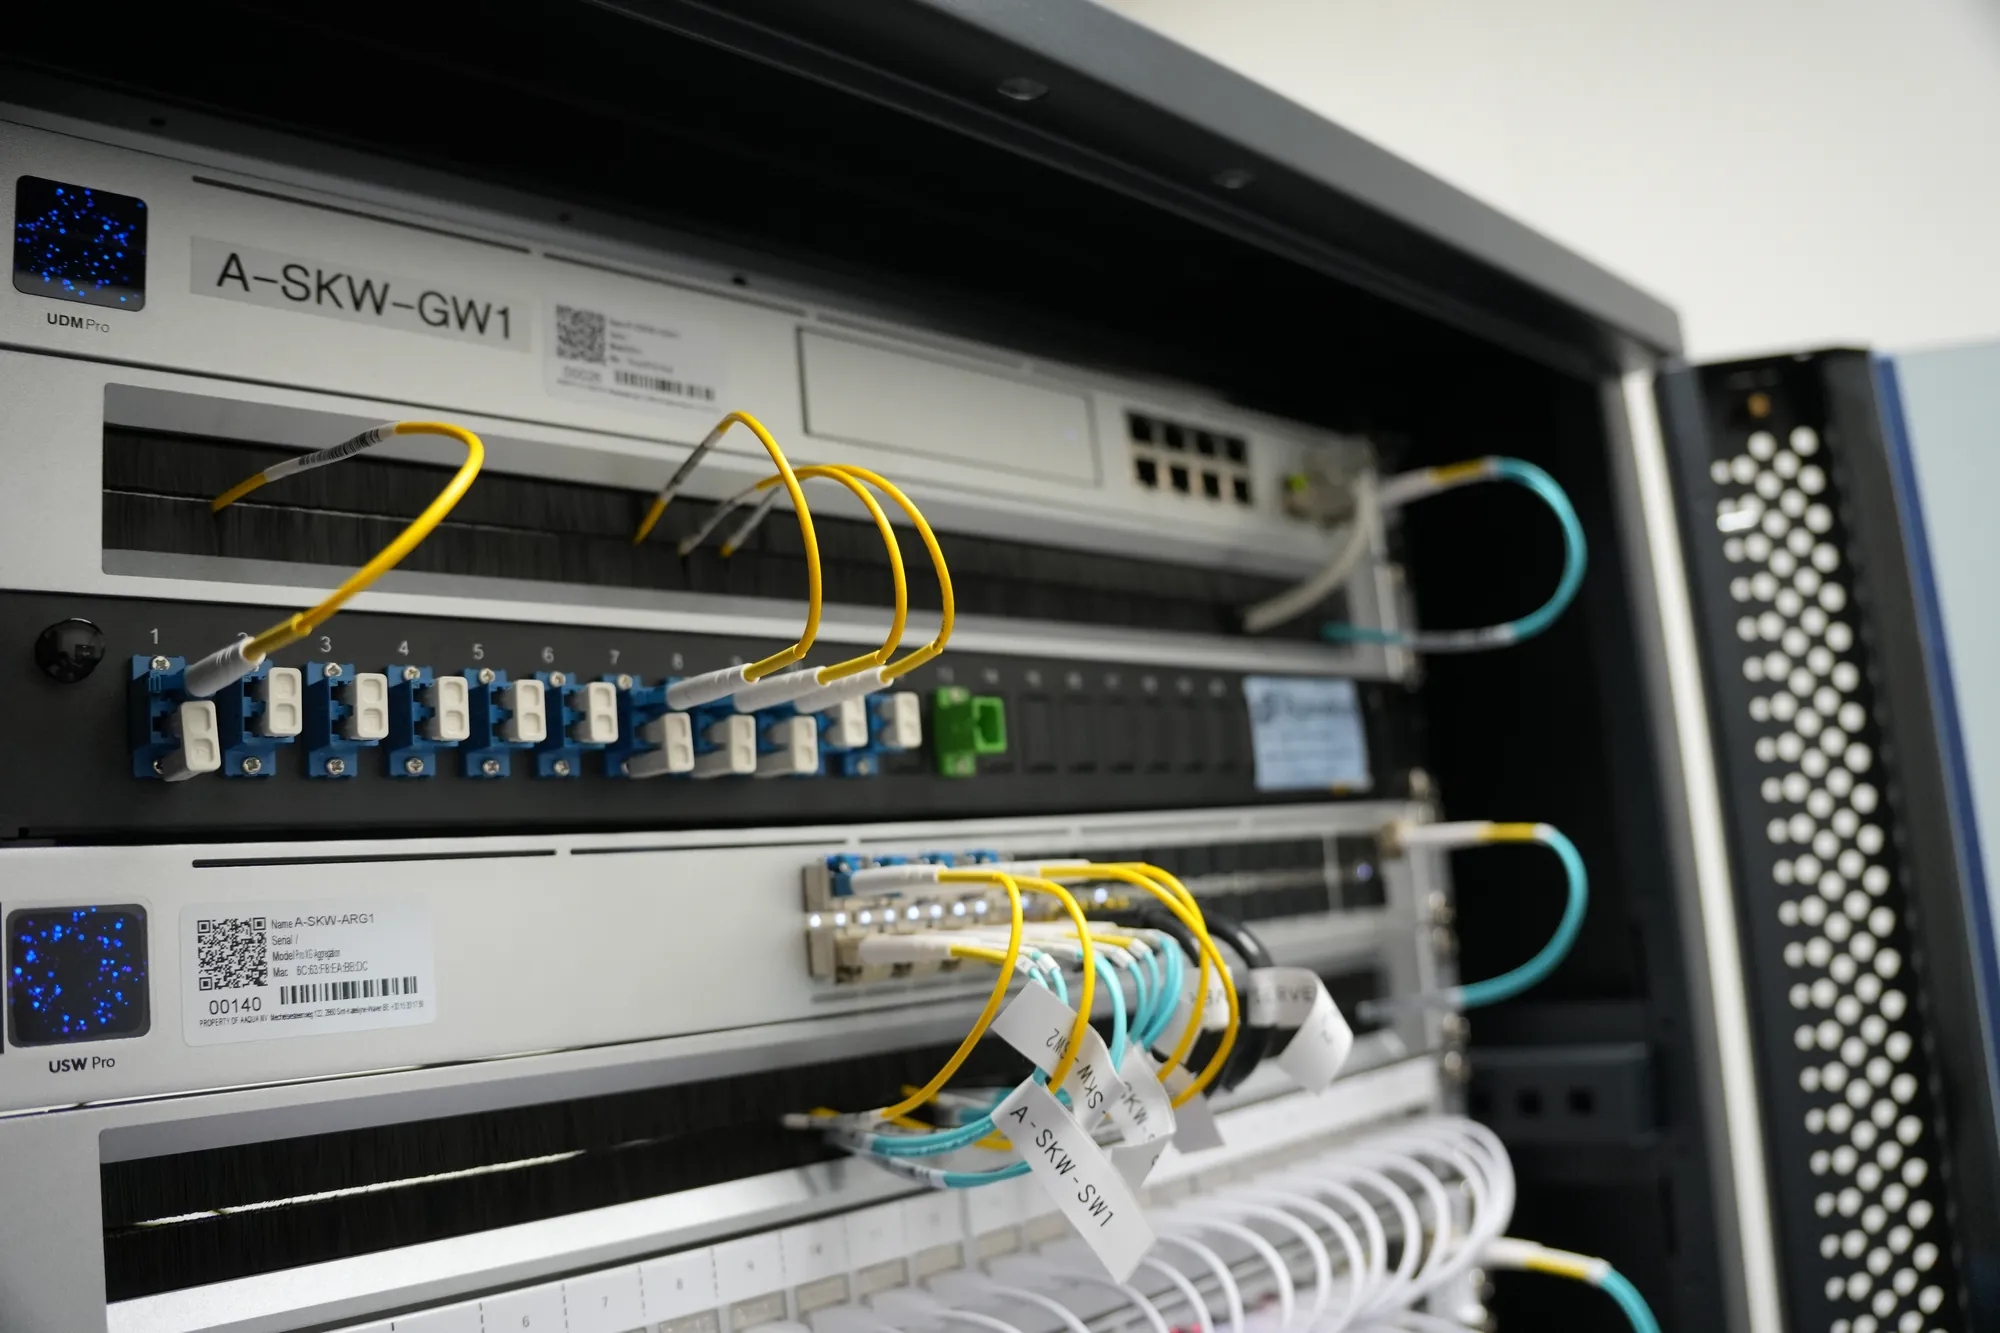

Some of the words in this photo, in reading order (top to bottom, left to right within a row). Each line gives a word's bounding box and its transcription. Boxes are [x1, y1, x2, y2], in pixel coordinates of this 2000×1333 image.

[216, 252, 510, 340] A-SKW-GW1
[46, 312, 83, 329] UDM
[86, 318, 110, 333] Pro
[150, 628, 159, 645] 1
[319, 635, 332, 653] 3
[399, 640, 409, 656] 4
[472, 643, 485, 660] 5
[541, 646, 555, 664] 6
[610, 649, 621, 665] 7
[271, 919, 293, 930] Name
[294, 913, 375, 928] A-SKW-ARG1
[271, 934, 293, 946] Serial
[272, 949, 295, 961] Model
[273, 967, 289, 978] Mac
[209, 996, 262, 1015] 00140
[199, 1017, 230, 1028] PROPERTY
[48, 1056, 88, 1074] USW
[92, 1056, 116, 1070] Pro
[1009, 1105, 1115, 1228] A-SKW-SW1
[522, 1315, 530, 1328] 6
